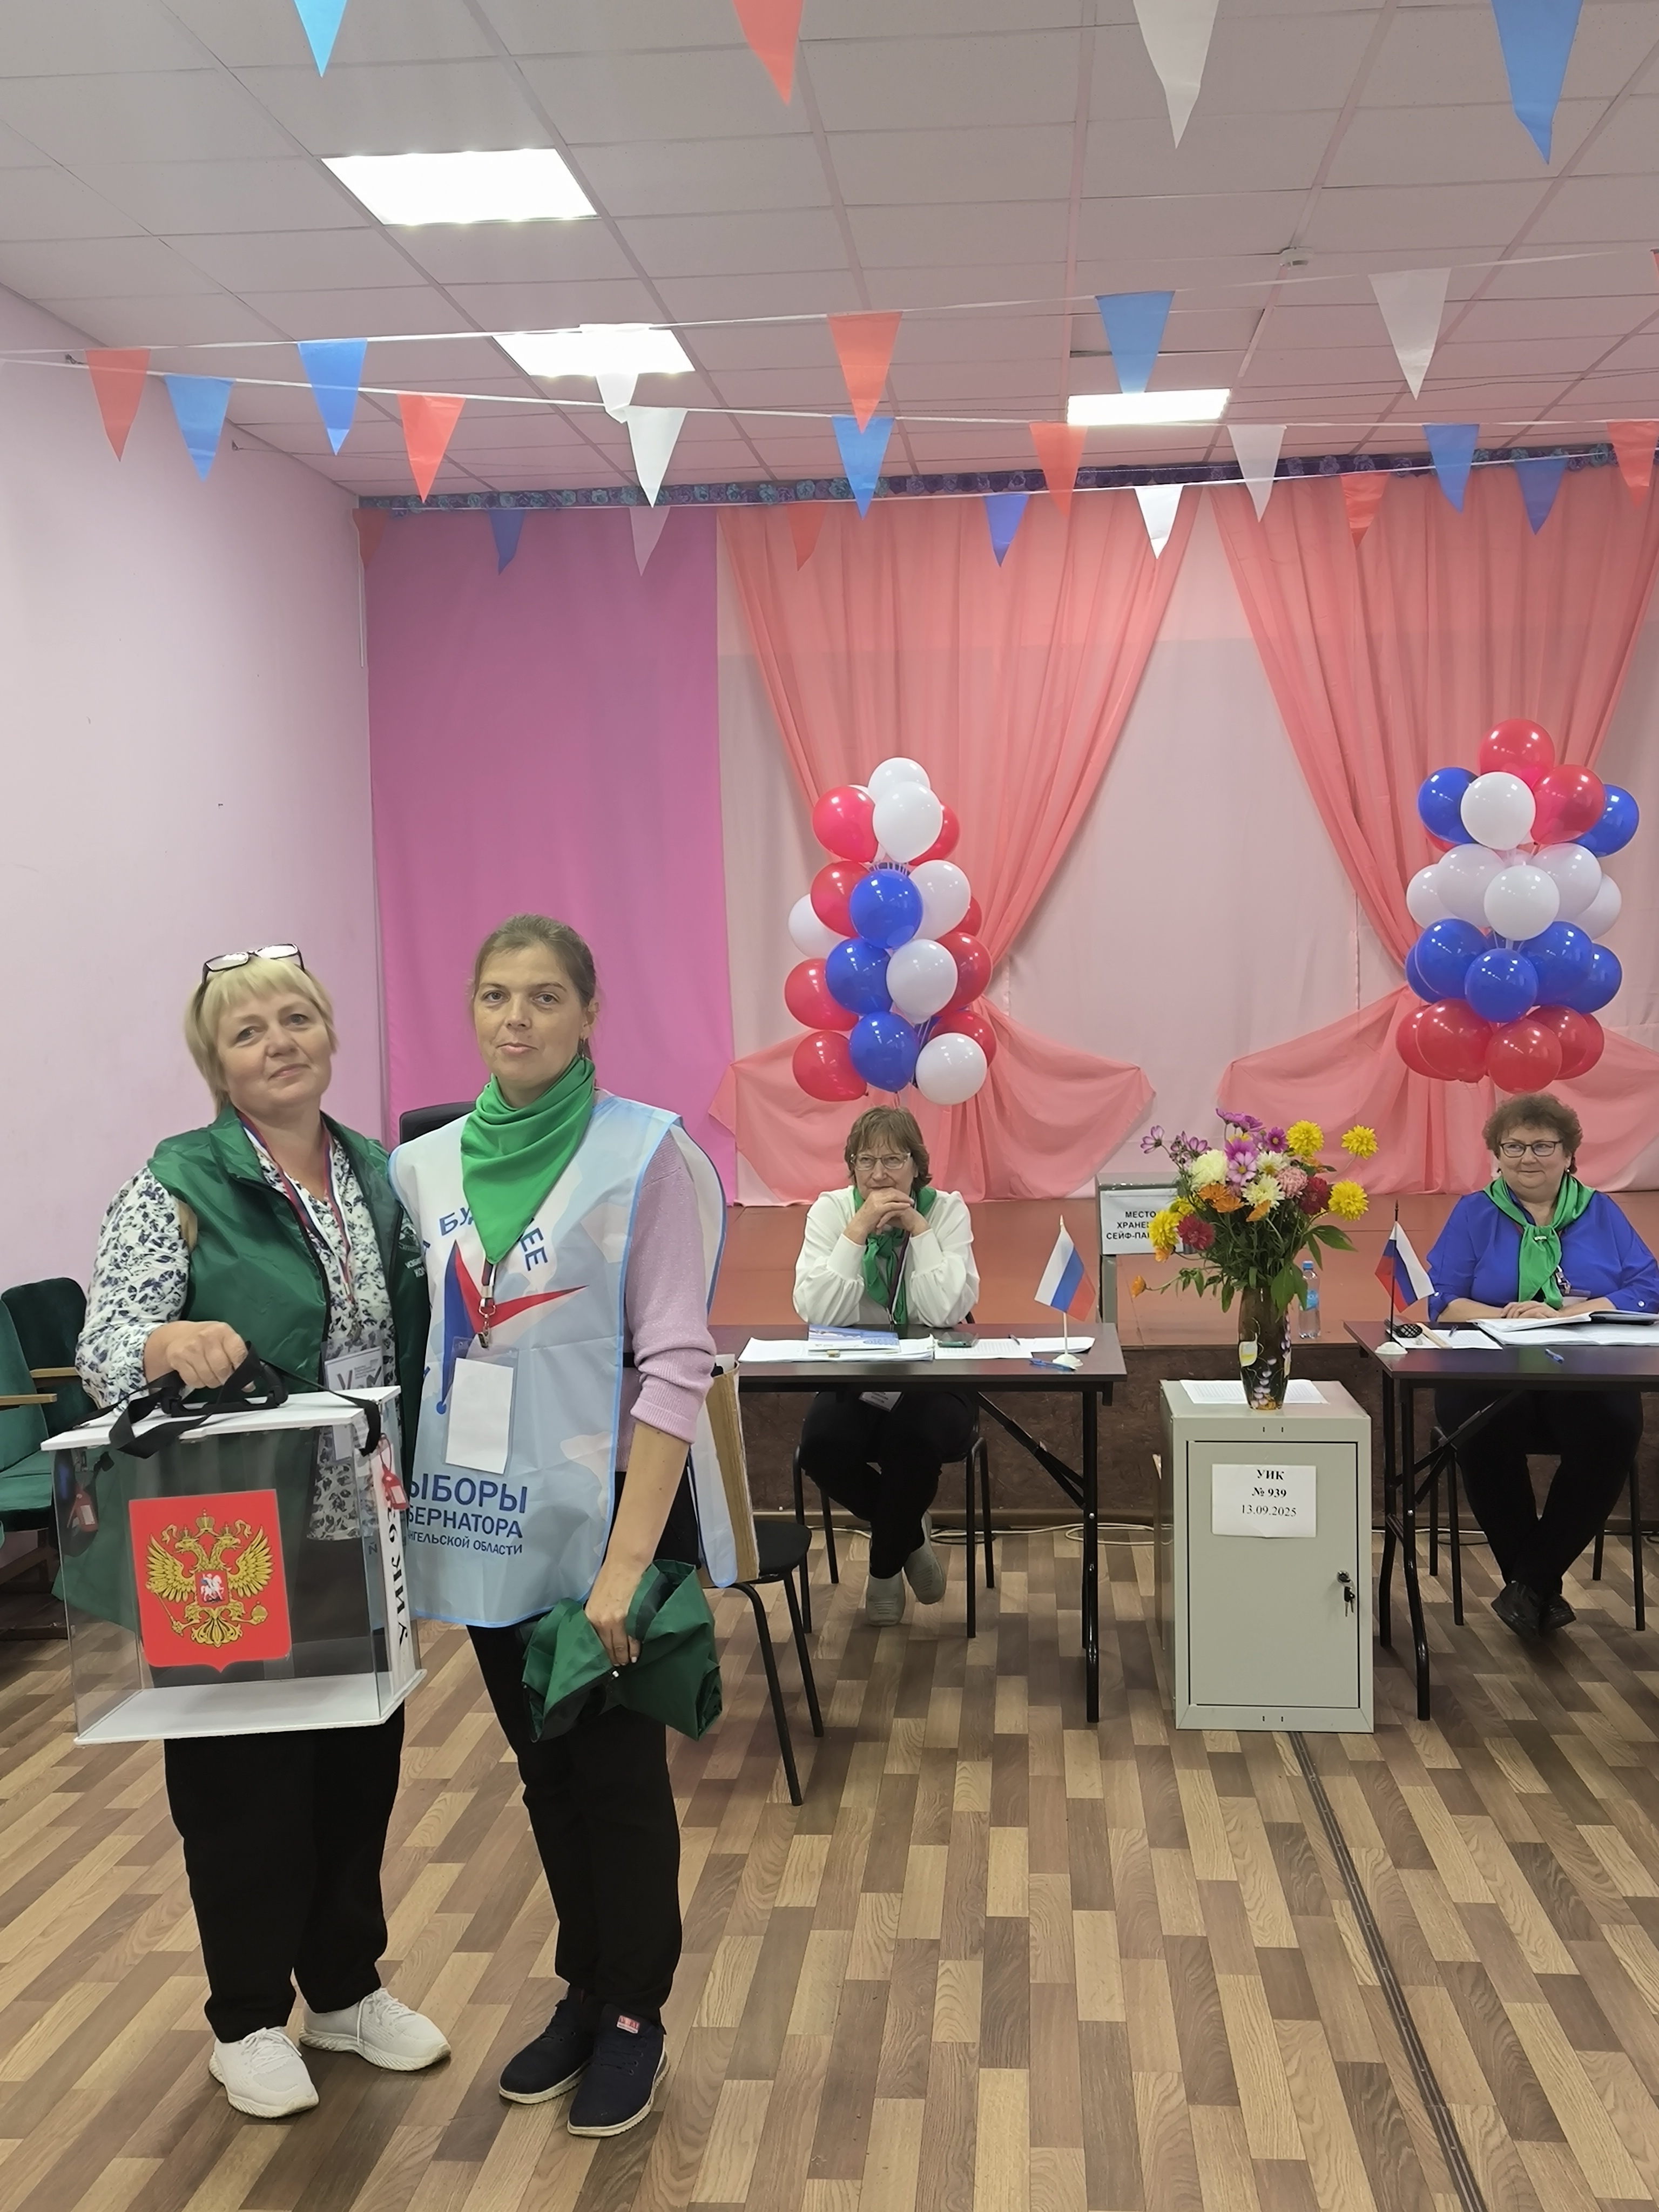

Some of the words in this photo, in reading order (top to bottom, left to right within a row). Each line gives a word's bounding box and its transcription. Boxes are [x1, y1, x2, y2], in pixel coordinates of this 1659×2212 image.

[1257, 1469, 1284, 1480] УИК
[409, 1473, 528, 1514] ЫБОРЫ
[1252, 1487, 1265, 1496] №
[1267, 1488, 1287, 1498] 939
[408, 1505, 523, 1539] БЕРНАТОРА
[1242, 1505, 1297, 1517] 13.09.2025
[387, 1507, 399, 1543] 93
[473, 1540, 523, 1556] ОБЛАСТИ
[390, 1553, 408, 1648] УИК
